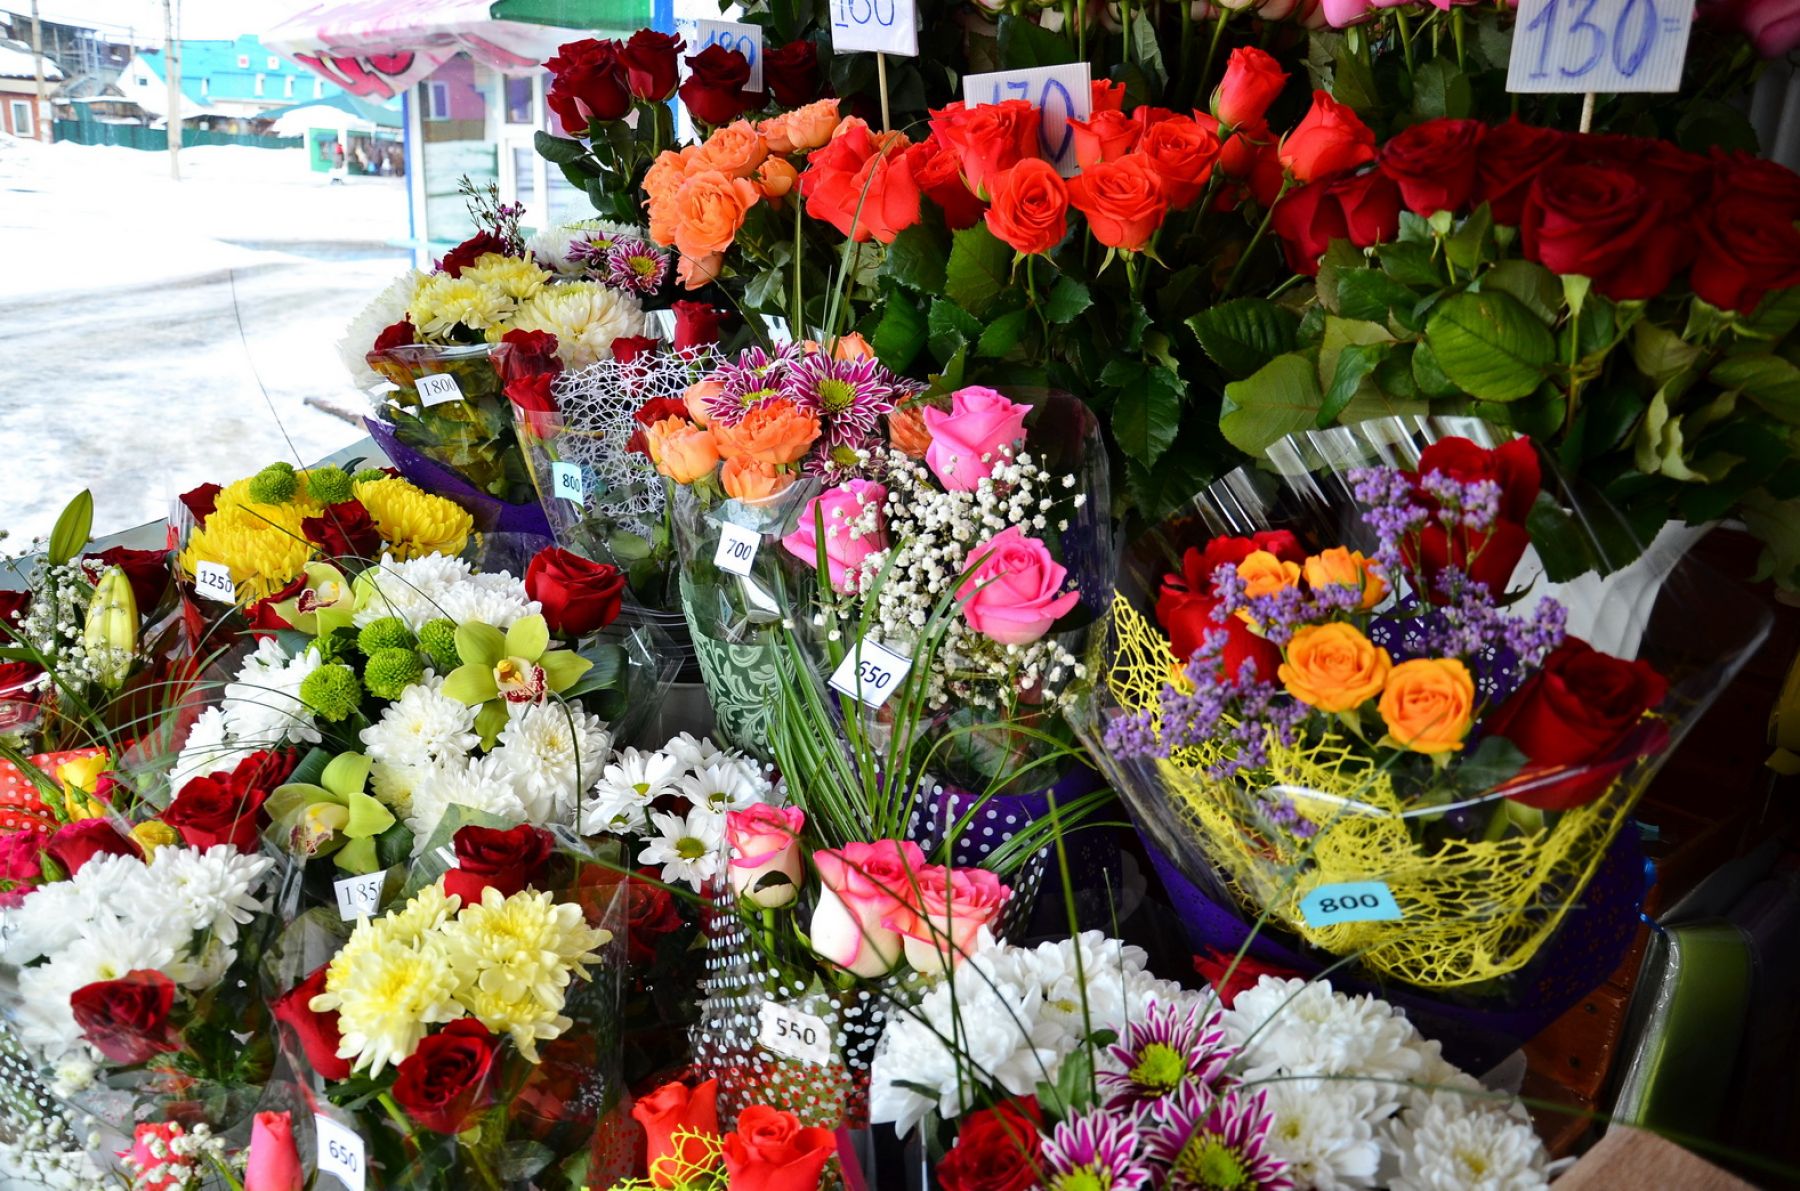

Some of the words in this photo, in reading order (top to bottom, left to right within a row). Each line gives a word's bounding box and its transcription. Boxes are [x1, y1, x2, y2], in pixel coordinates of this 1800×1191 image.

[423, 378, 457, 396] 1800
[562, 473, 580, 493] 800
[726, 538, 752, 560] 700
[200, 570, 233, 593] 1250
[854, 660, 891, 689] 650
[345, 881, 383, 905] 185
[1319, 893, 1379, 913] 800
[776, 1017, 816, 1045] 550
[329, 1140, 357, 1173] 650
